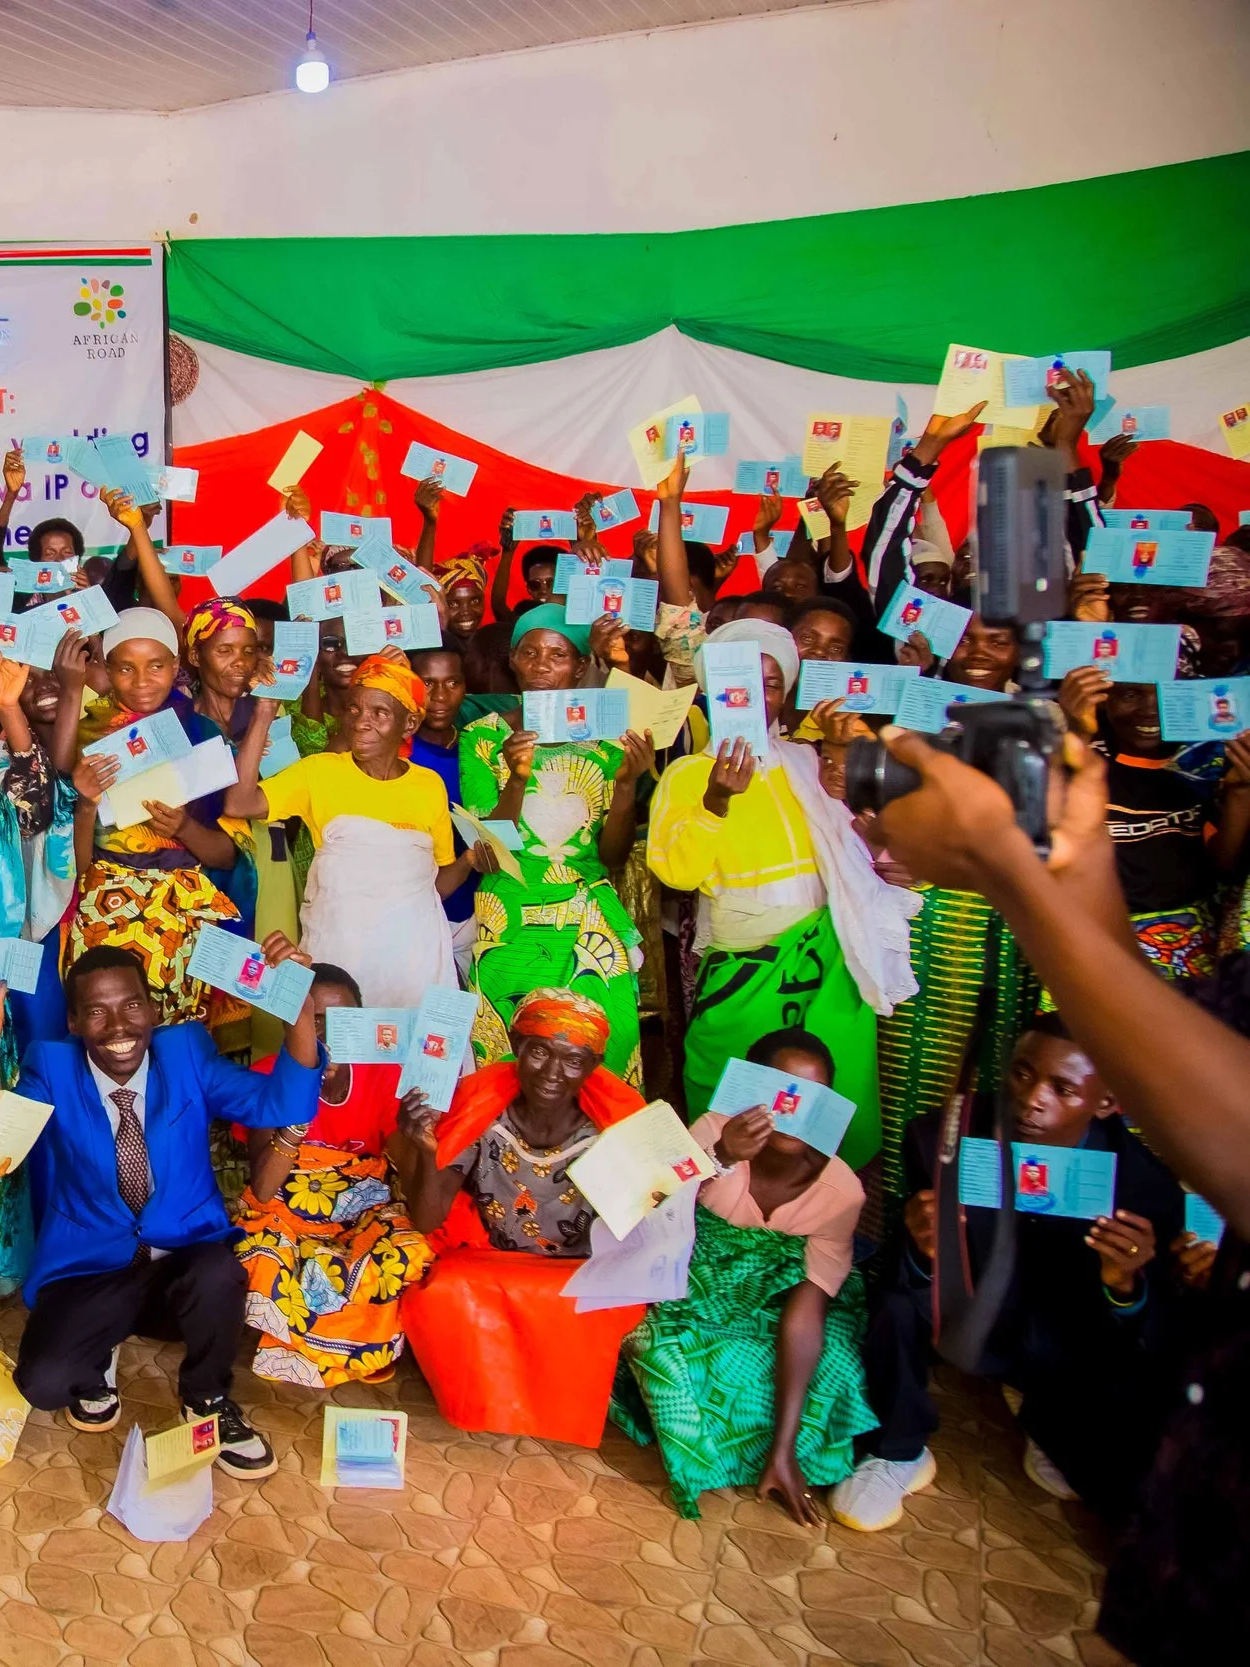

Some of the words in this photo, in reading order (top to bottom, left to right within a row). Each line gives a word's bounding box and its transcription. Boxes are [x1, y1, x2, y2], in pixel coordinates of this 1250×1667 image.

[73, 333, 139, 346] AFRICAN
[87, 347, 126, 360] ROAD
[44, 473, 70, 501] IP
